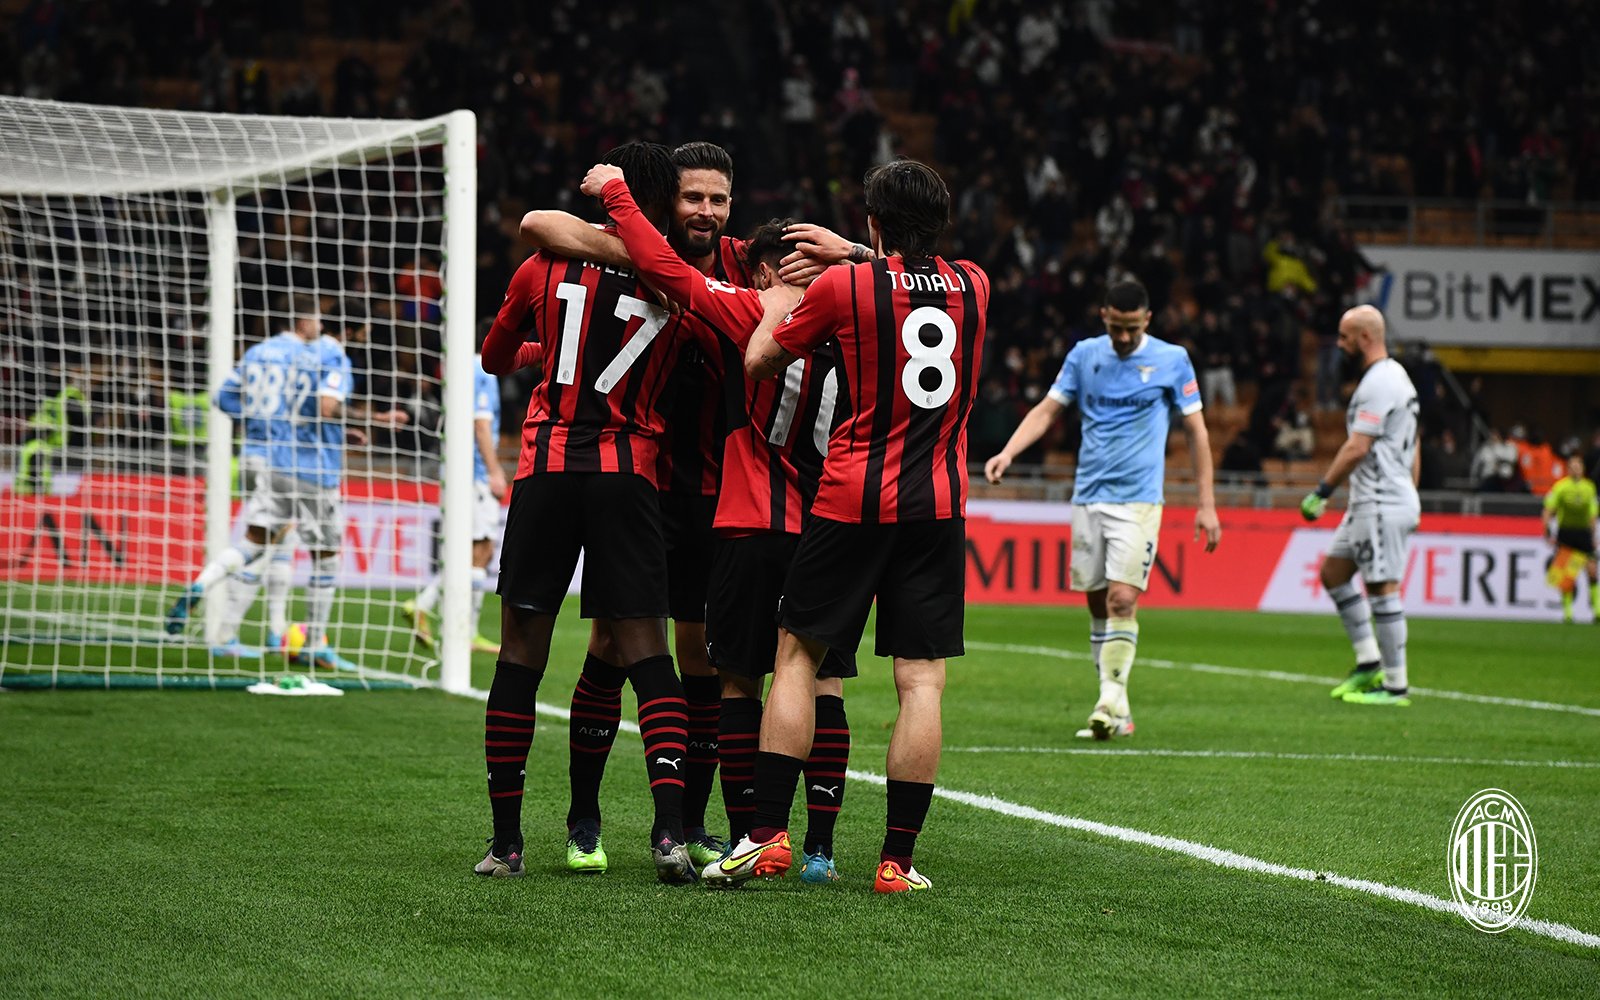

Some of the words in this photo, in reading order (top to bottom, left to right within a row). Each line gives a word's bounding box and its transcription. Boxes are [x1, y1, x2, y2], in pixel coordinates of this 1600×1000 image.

[886, 270, 967, 292] TONALI
[556, 281, 671, 394] 17
[901, 306, 957, 409] 8
[965, 538, 1184, 594] MILN
[579, 726, 609, 737] ACM
